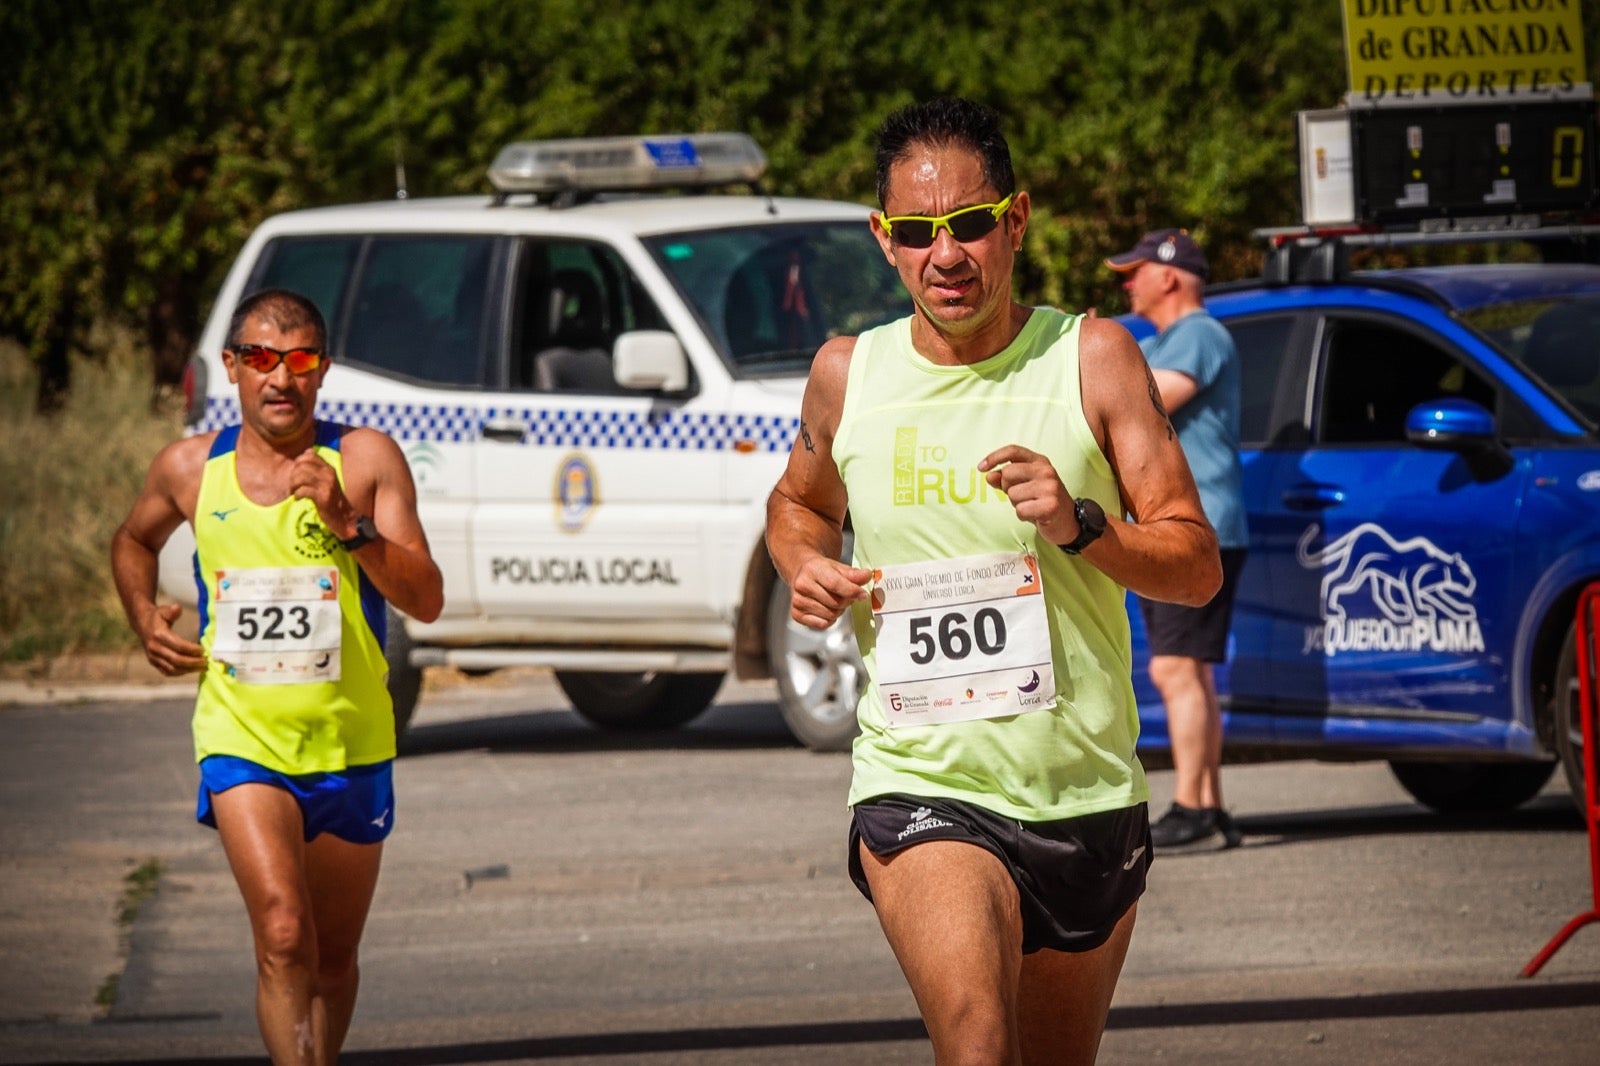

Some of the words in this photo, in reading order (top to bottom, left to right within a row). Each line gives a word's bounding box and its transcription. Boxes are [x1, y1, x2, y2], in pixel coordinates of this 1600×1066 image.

[1358, 30, 1392, 60] de
[1402, 23, 1572, 59] GRANADA
[1365, 67, 1575, 100] DEPORTES
[896, 430, 913, 503] READY
[919, 446, 947, 462] TO
[490, 558, 589, 585] POLICIA
[597, 558, 679, 585] LOCAL
[994, 562, 1016, 577] 2022
[238, 606, 311, 640] 523
[909, 607, 1007, 665] 560
